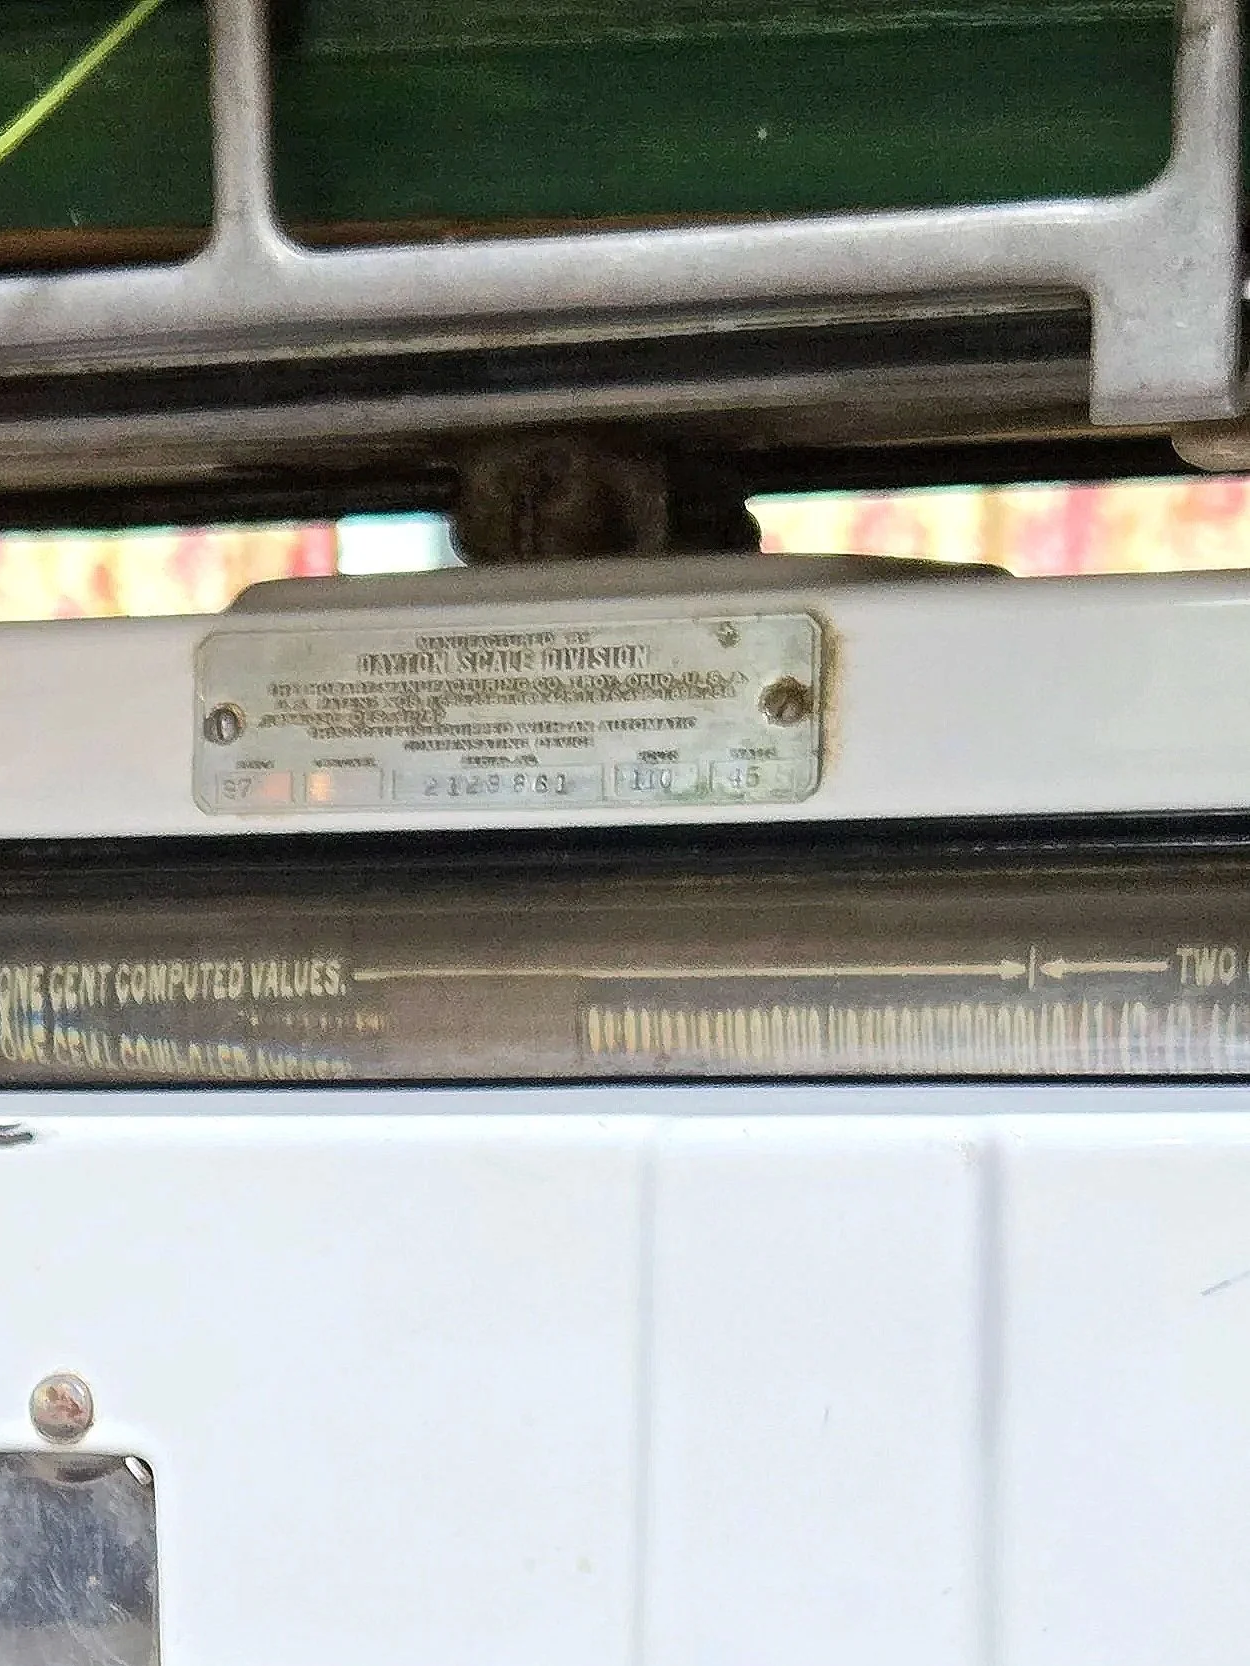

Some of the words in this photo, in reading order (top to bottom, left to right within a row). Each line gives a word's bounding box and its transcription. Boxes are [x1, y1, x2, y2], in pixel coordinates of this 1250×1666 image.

[357, 652, 450, 676] DAYTON
[457, 649, 535, 674] SCALE
[541, 645, 649, 672] DIVISION
[51, 964, 111, 1008] CENT
[114, 962, 245, 1003] COMPUTED
[1176, 947, 1236, 986] TWO
